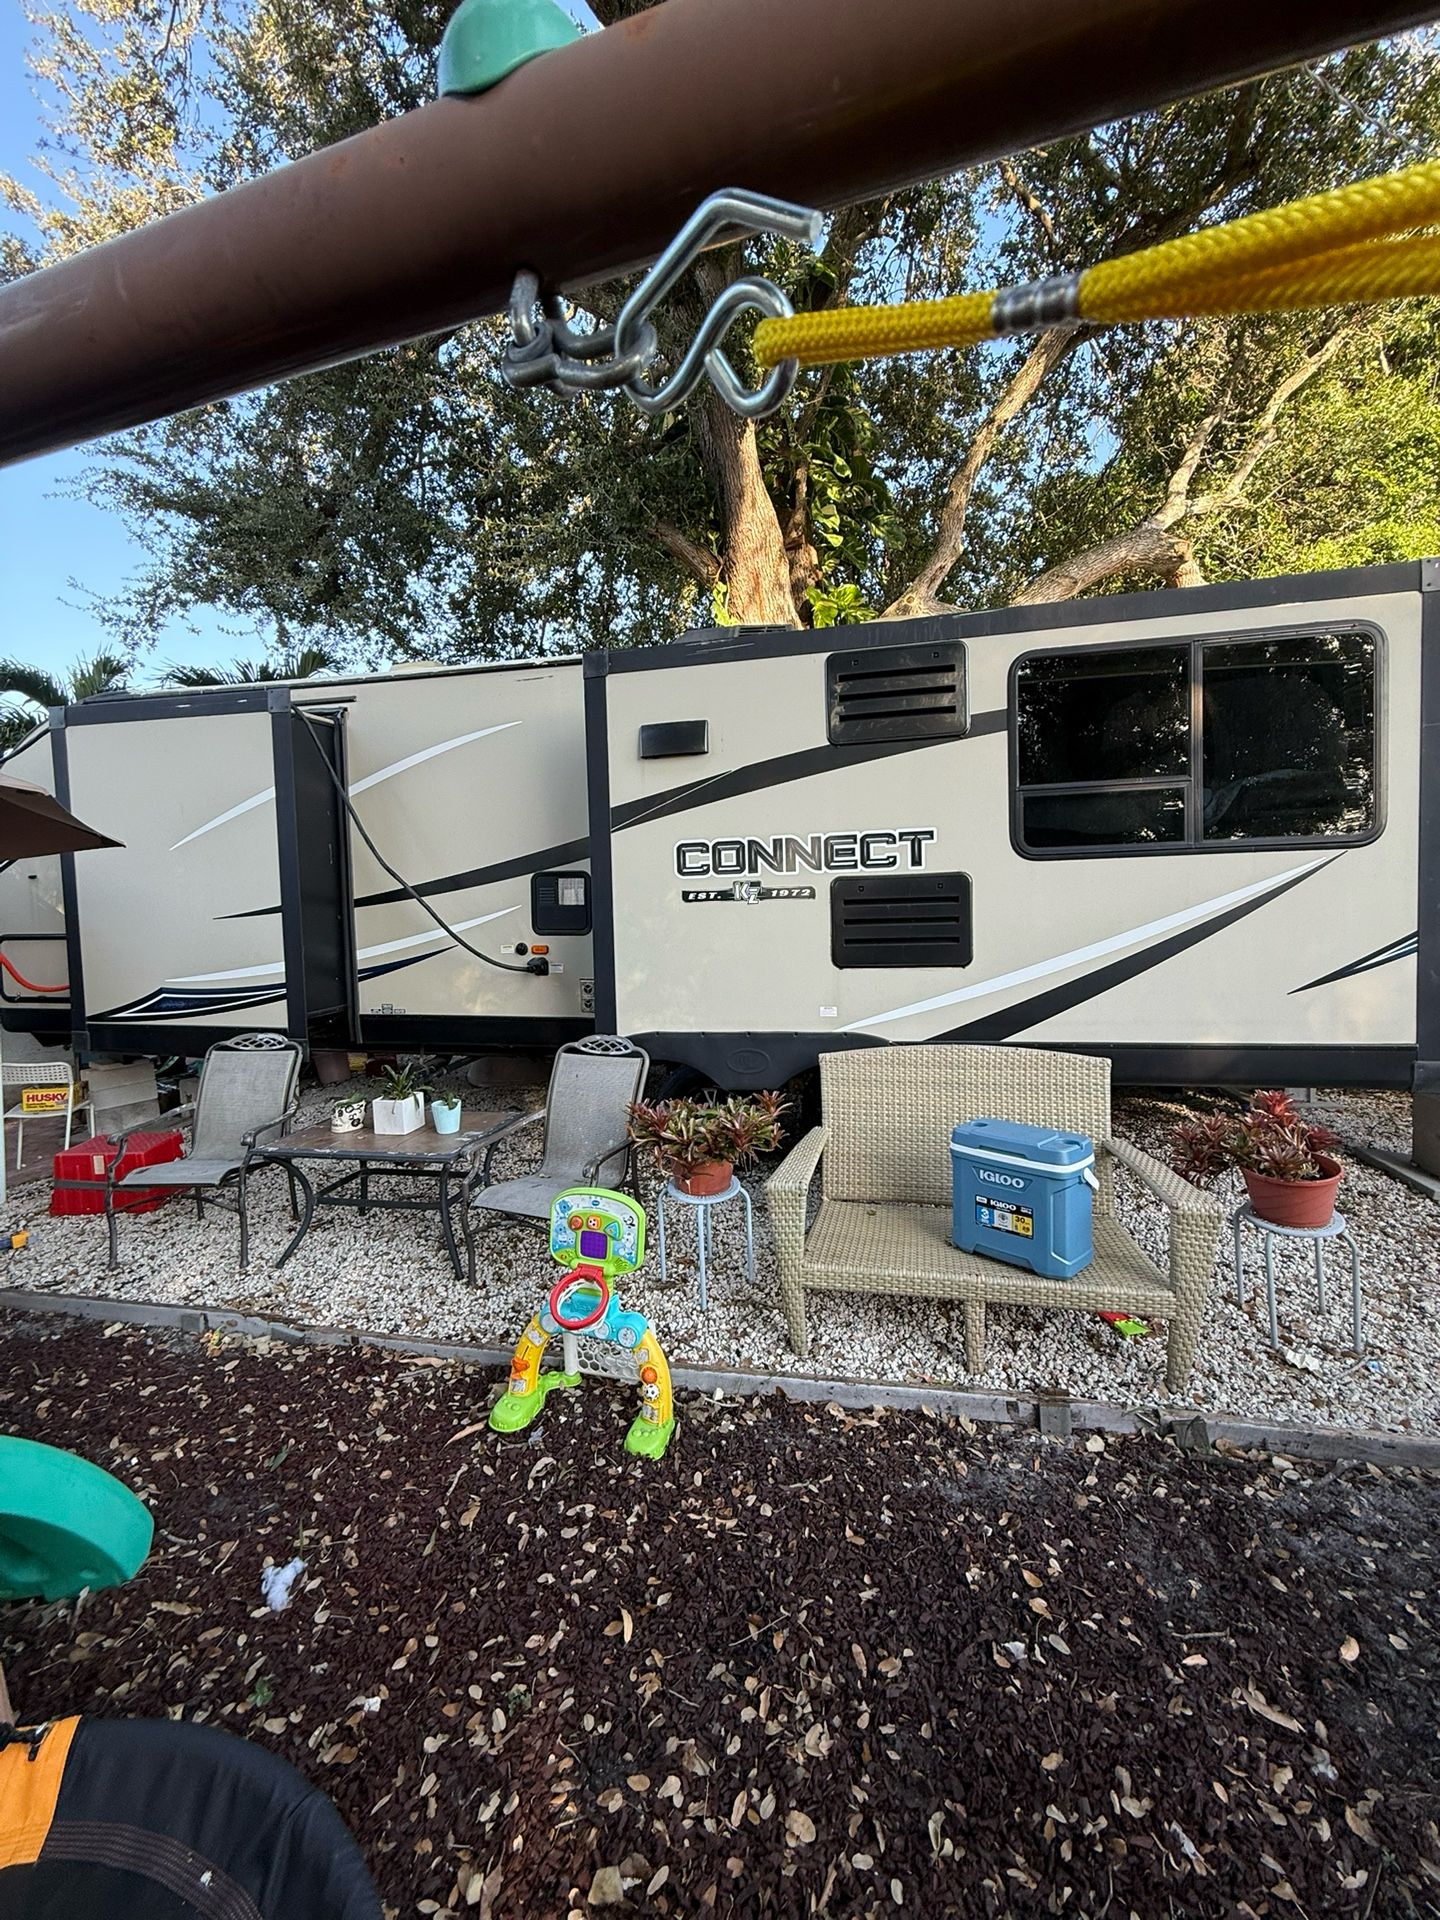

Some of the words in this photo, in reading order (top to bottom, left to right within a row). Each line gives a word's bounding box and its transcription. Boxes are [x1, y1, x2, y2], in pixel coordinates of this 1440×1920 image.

[675, 829, 936, 878] CONNECT
[688, 891, 722, 901] EST.
[770, 888, 811, 898] 1972
[26, 1093, 67, 1102] HUSKY
[979, 1169, 1025, 1188] IGLOO
[990, 1199, 1017, 1211] IGLOO
